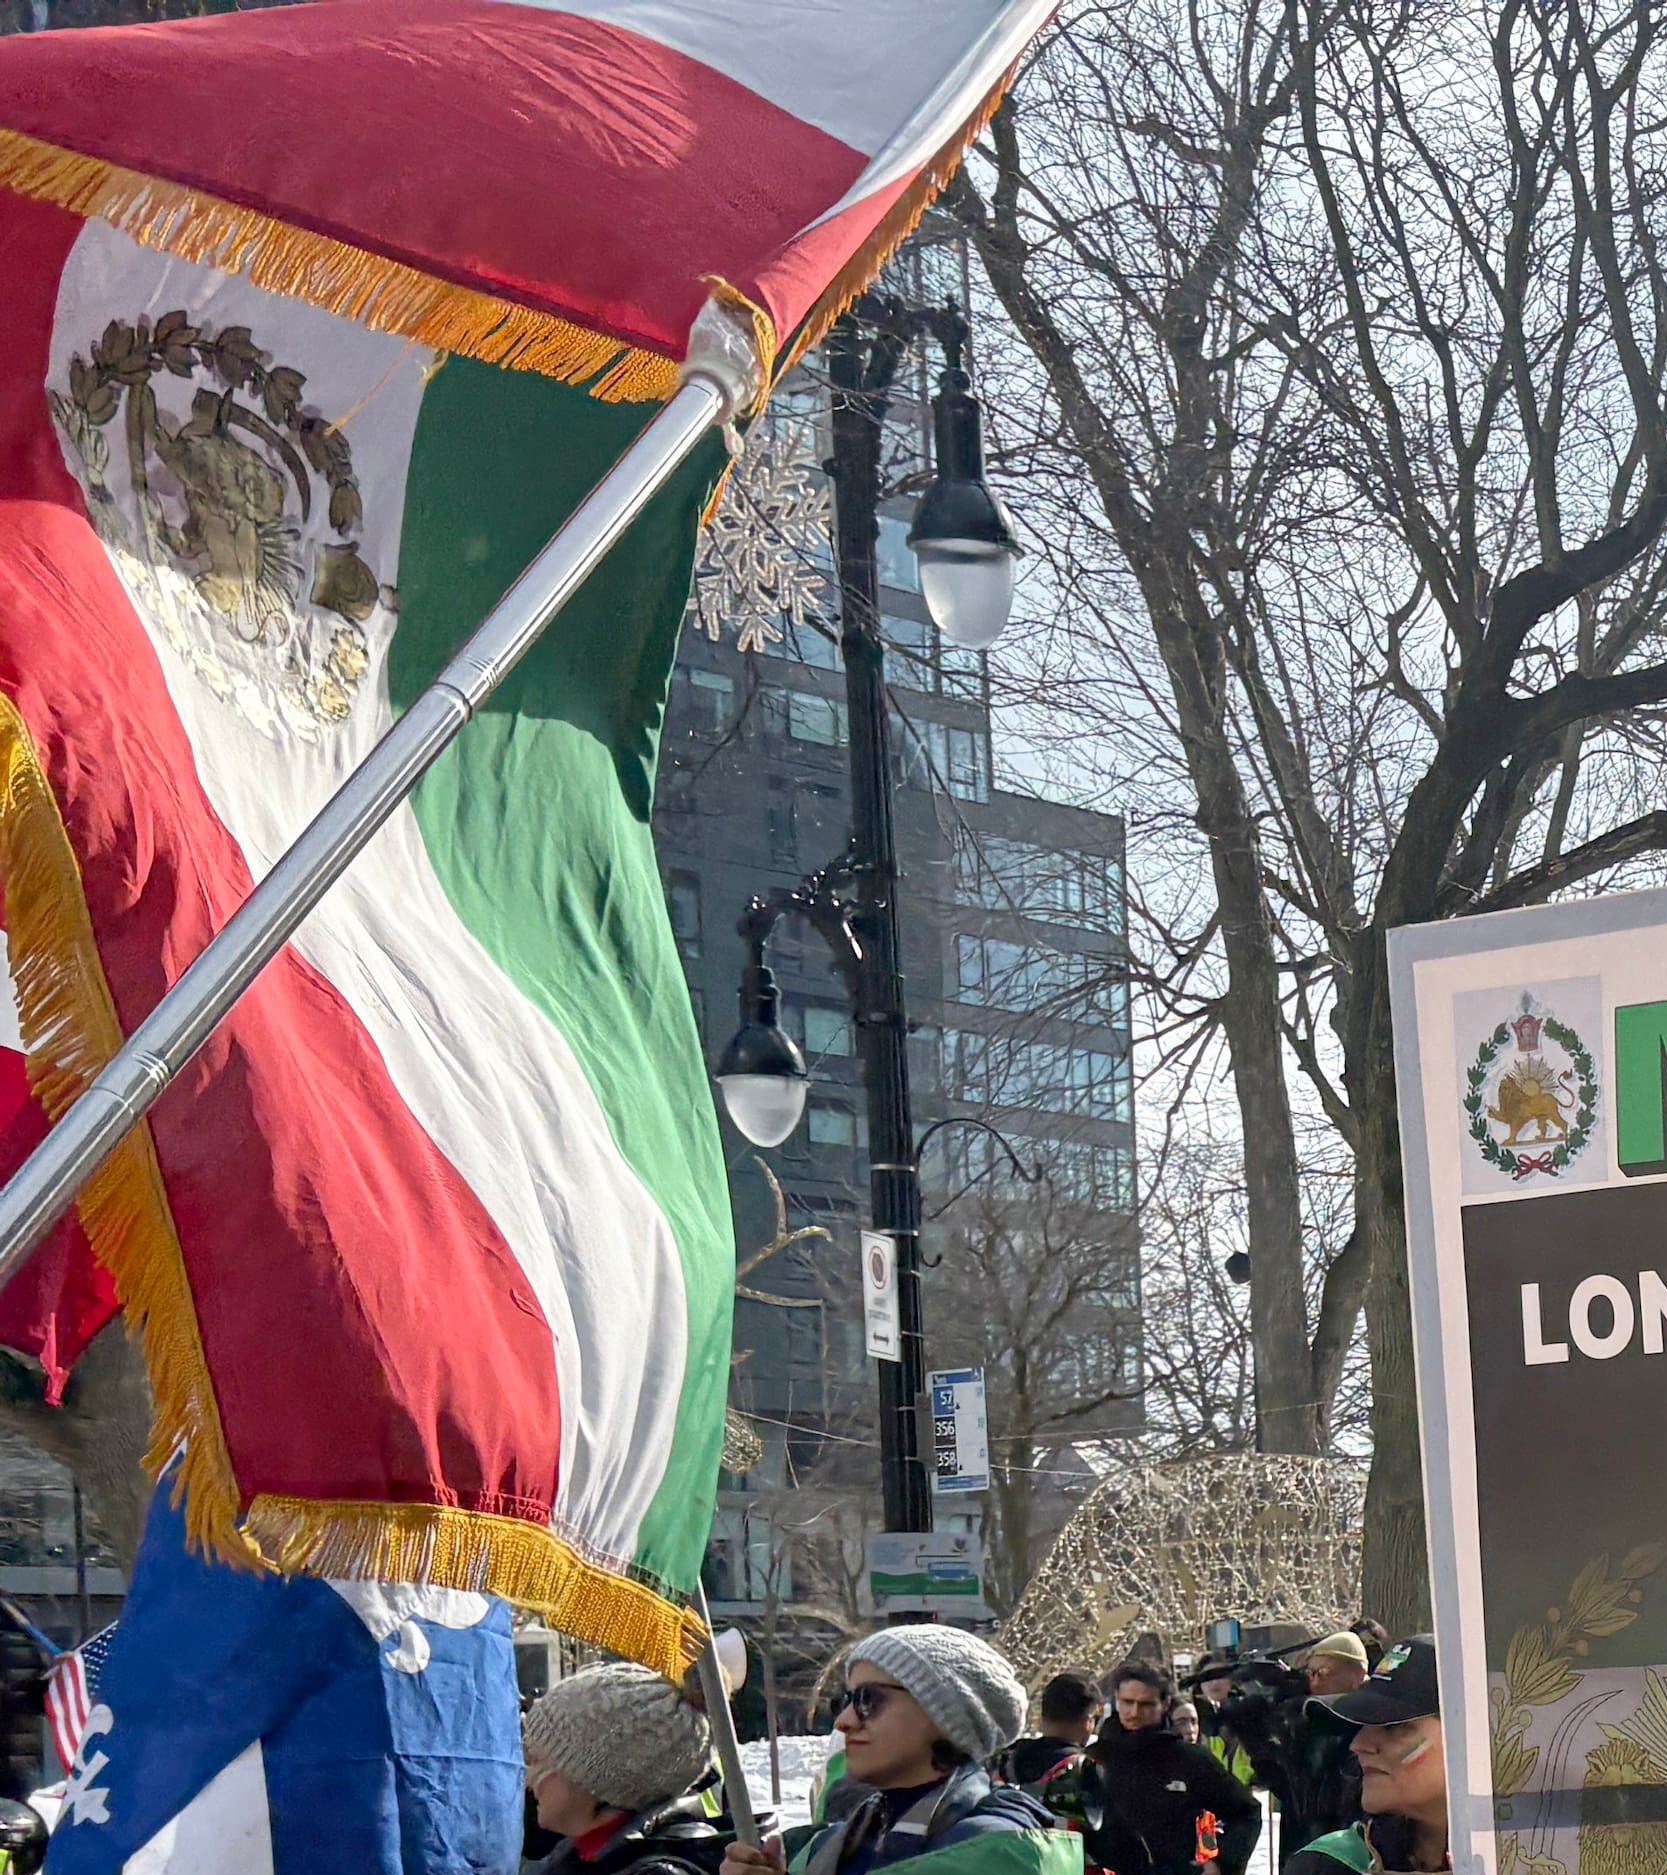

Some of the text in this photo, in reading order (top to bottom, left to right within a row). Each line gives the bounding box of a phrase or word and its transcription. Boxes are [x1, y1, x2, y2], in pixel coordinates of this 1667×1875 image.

[940, 1390, 952, 1405] 57
[935, 1421, 955, 1436] 356
[937, 1452, 956, 1467] 358
